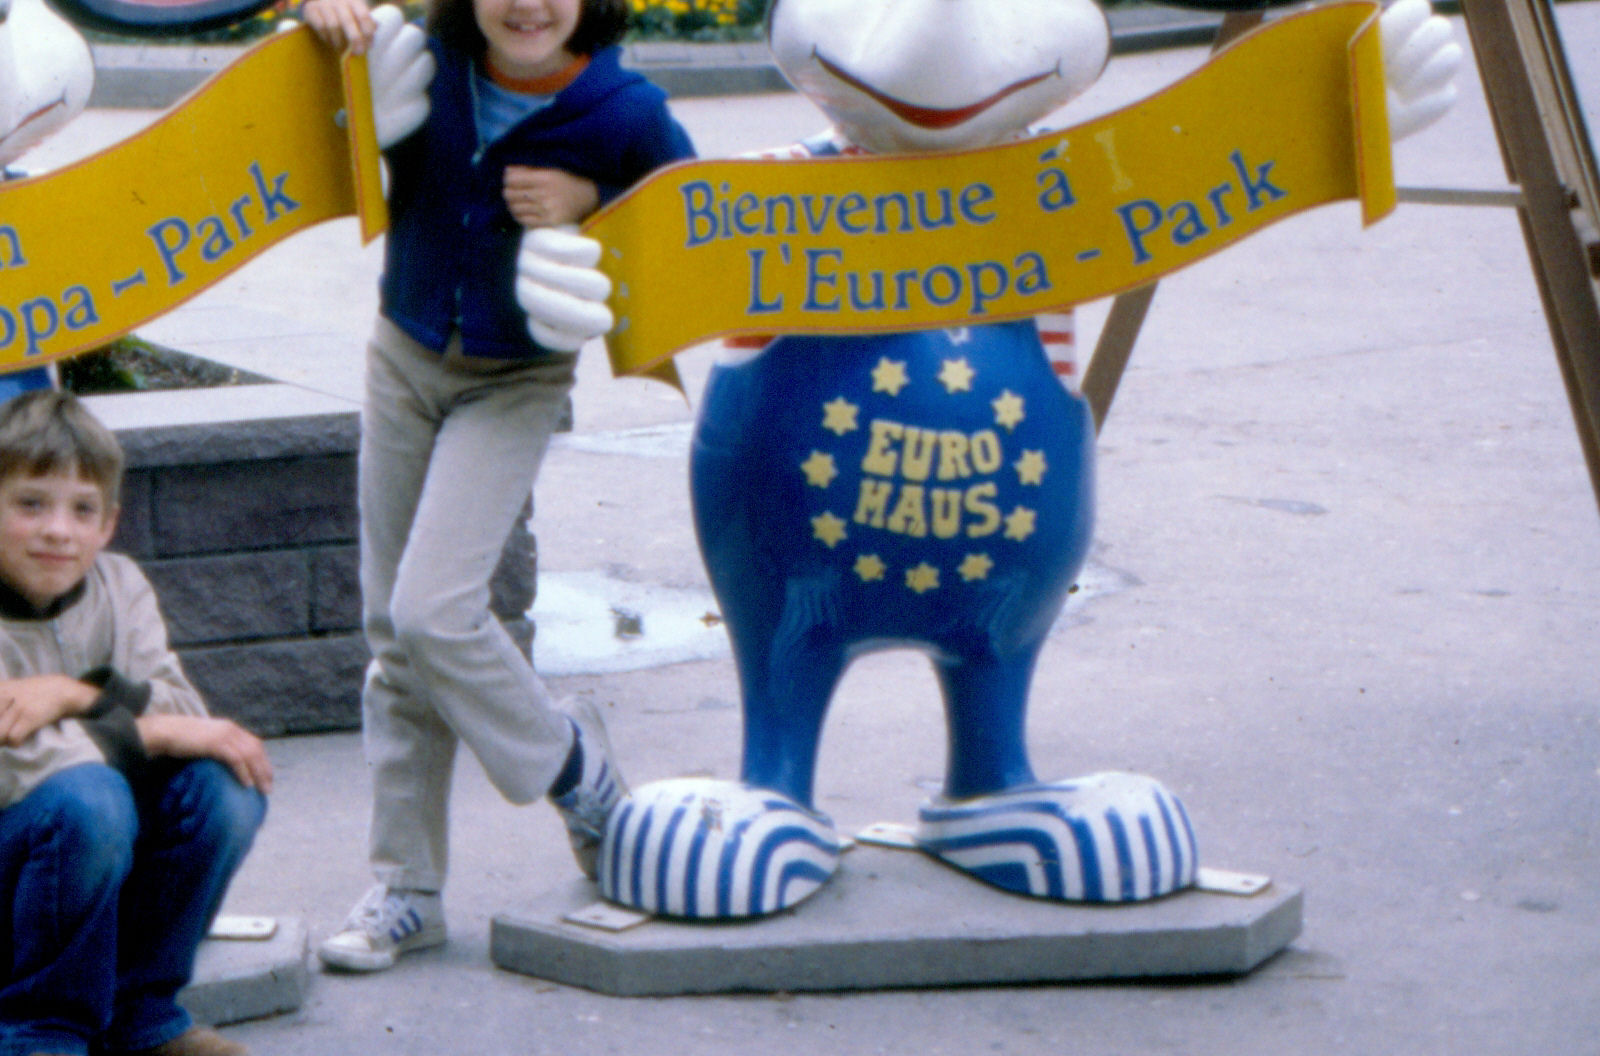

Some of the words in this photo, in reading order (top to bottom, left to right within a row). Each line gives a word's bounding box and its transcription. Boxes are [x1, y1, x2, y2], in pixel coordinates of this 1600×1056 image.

[145, 160, 301, 286] Park
[681, 180, 996, 248] Bienvenue
[1115, 148, 1289, 267] Park
[860, 419, 1003, 482] EURO
[852, 478, 1002, 539] HAUS
